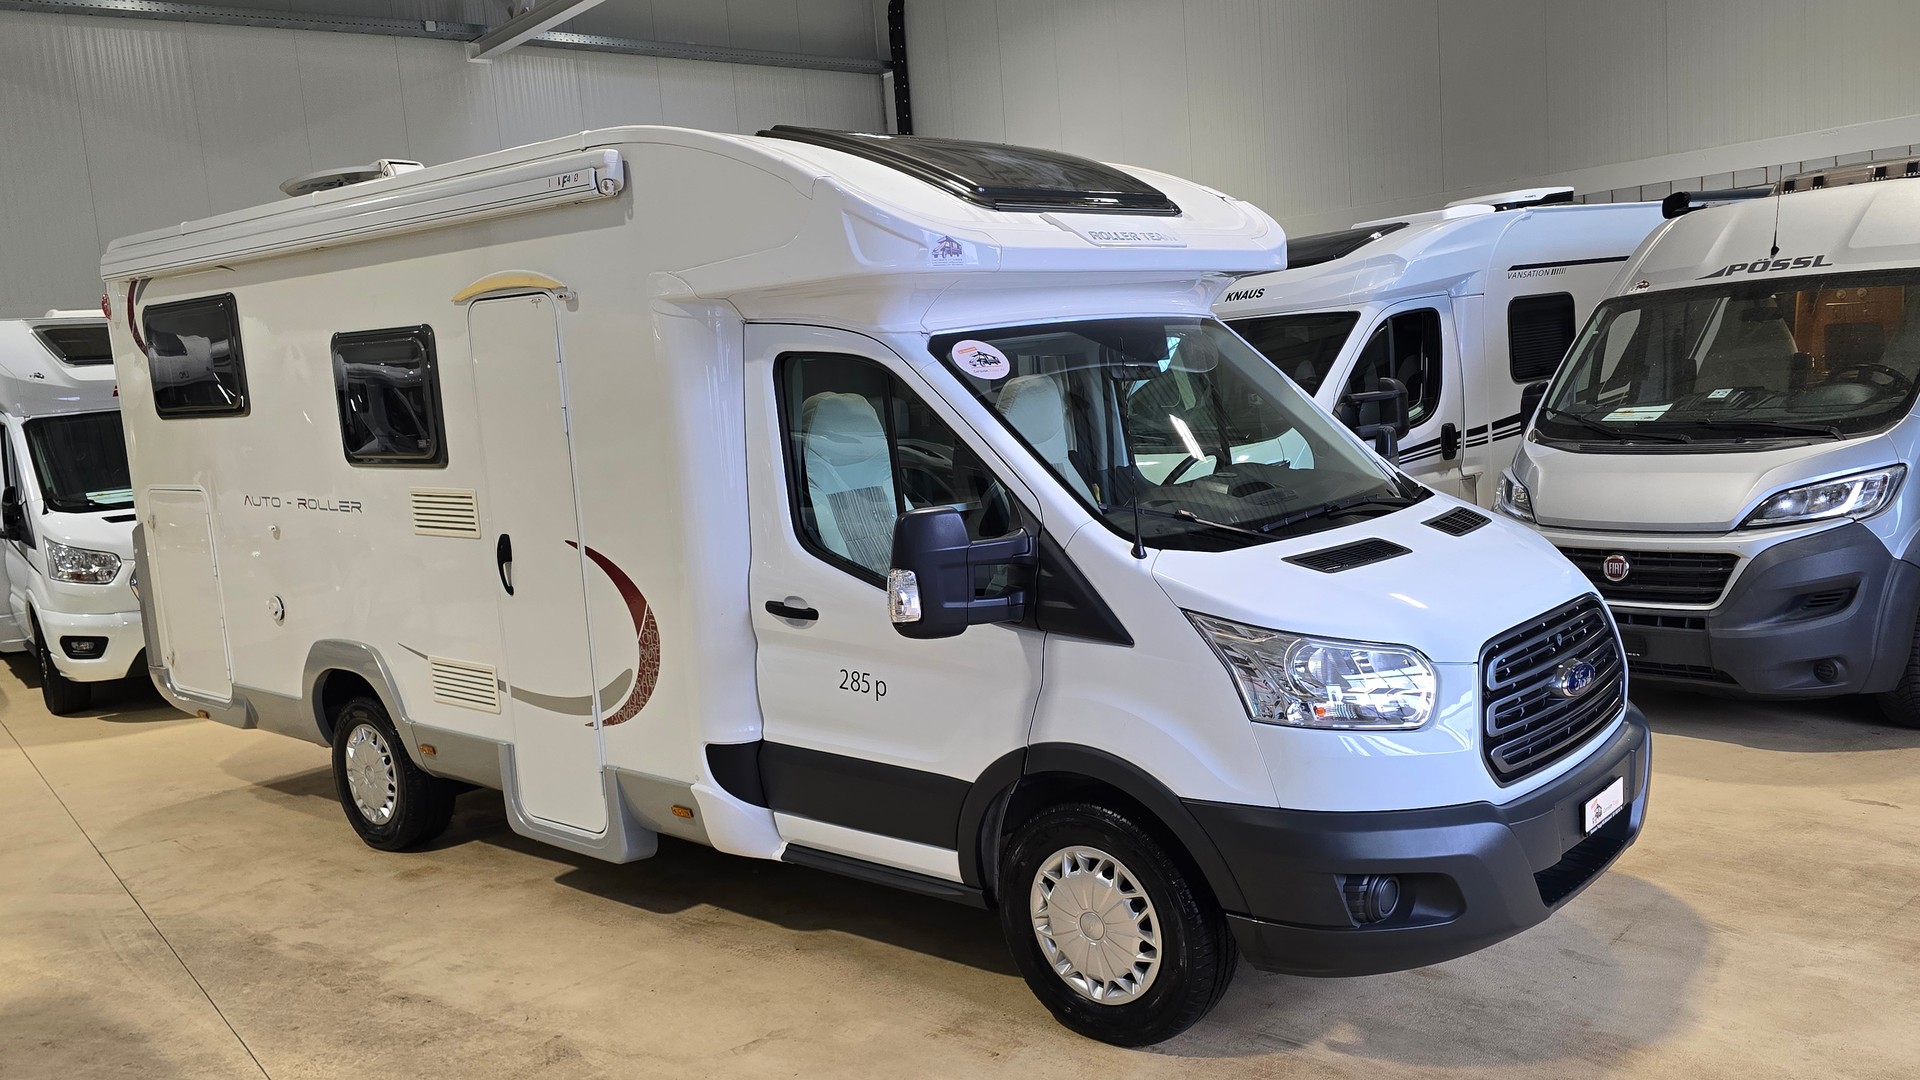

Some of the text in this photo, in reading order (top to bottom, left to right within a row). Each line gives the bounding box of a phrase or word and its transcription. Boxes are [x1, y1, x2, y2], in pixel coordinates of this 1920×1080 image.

[1088, 231, 1142, 241] ROLLER
[1724, 255, 1833, 277] PÖSSL
[1507, 269, 1550, 279] VANSATION
[1224, 288, 1265, 302] KNAUS
[244, 495, 281, 508] AUTO
[297, 498, 363, 513] ROLLER
[1608, 562, 1624, 575] FIAT
[839, 669, 887, 702] 285 p
